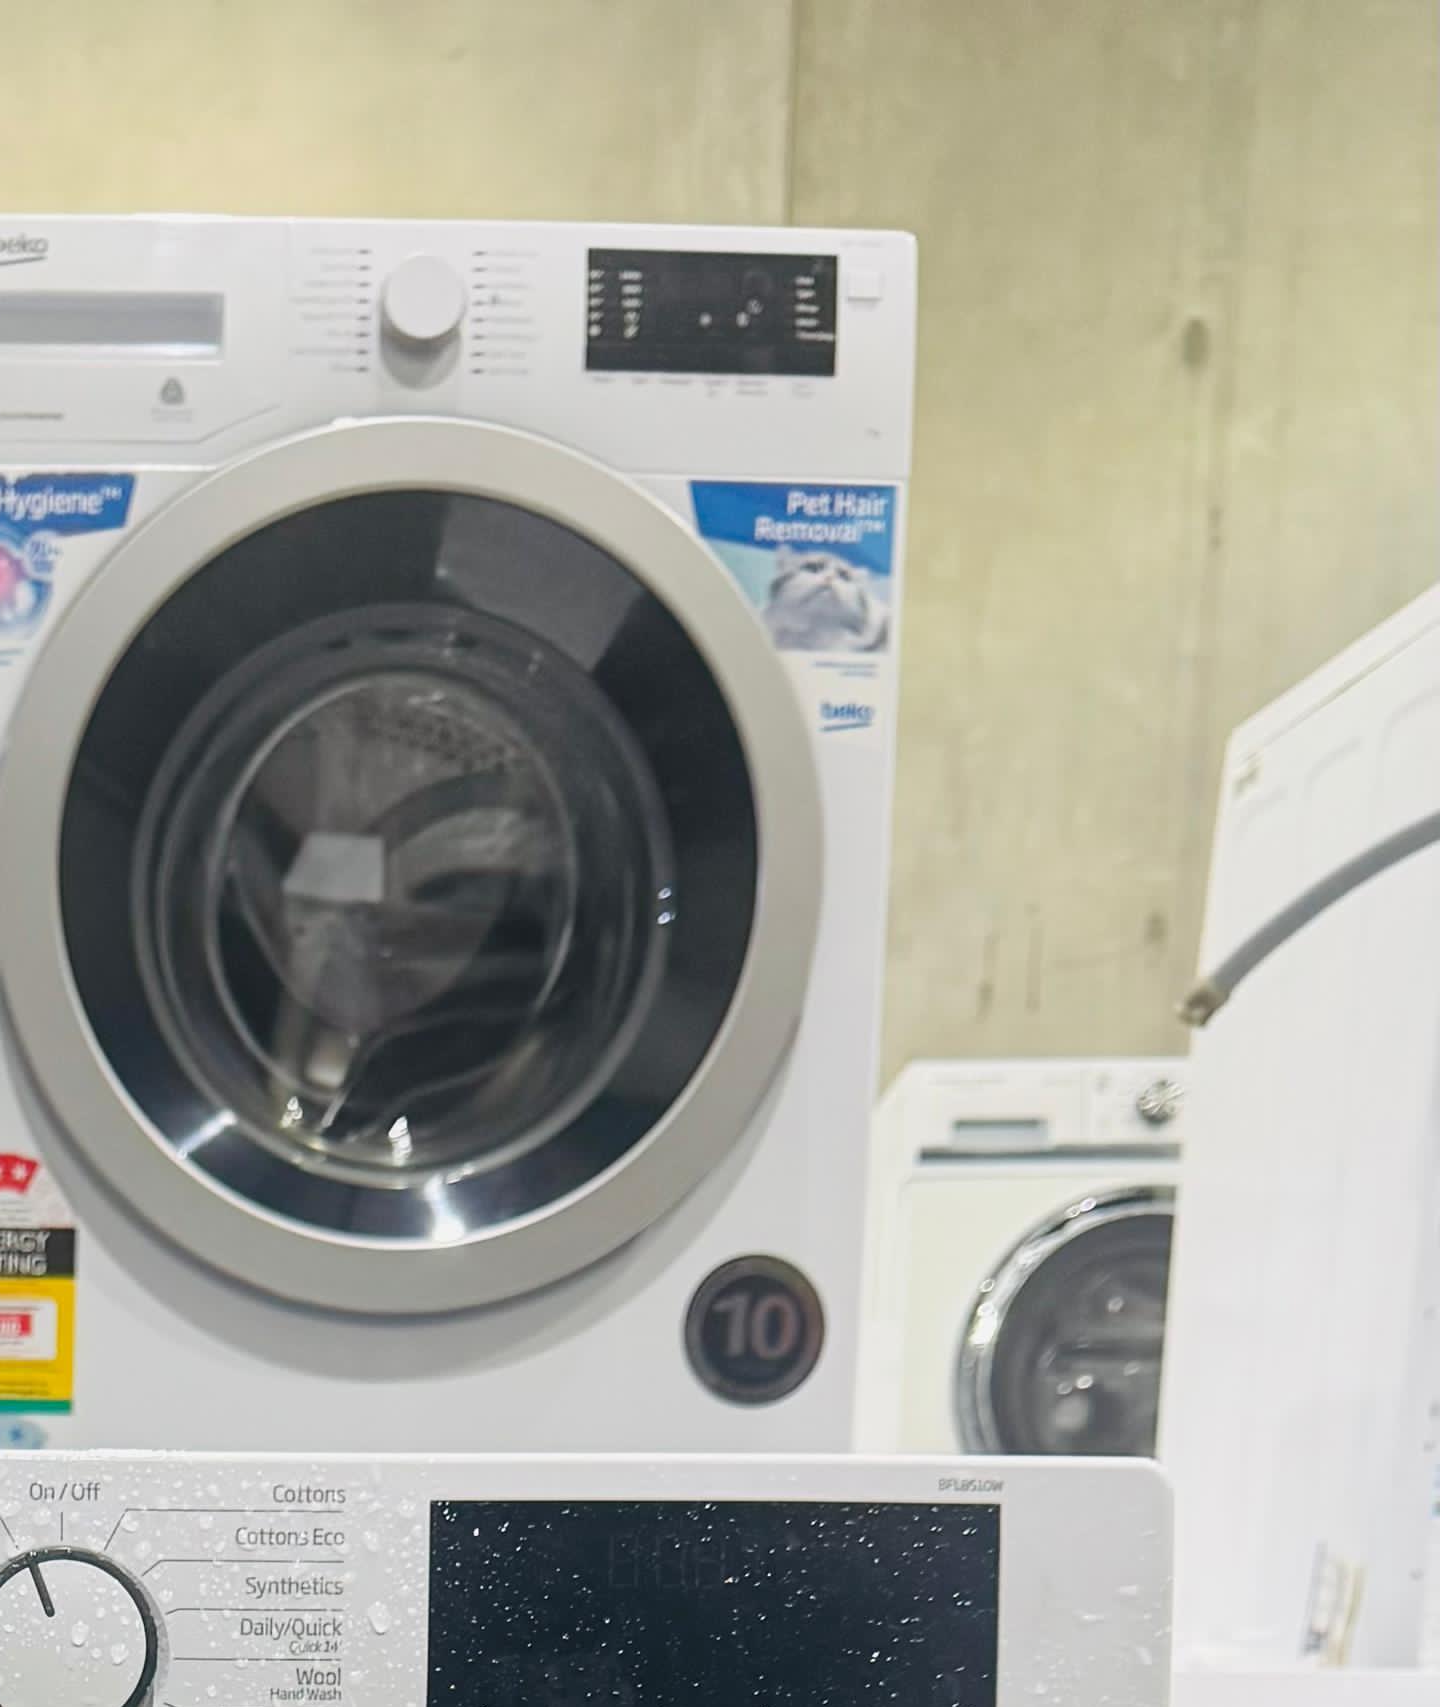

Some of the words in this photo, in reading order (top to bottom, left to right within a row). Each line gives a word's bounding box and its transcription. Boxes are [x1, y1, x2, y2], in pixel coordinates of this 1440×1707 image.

[787, 491, 830, 516] Pet
[834, 493, 888, 516] Hair
[711, 1292, 801, 1360] 10
[273, 1484, 346, 1504] Cottons
[235, 1527, 309, 1546] Cottons
[313, 1528, 345, 1546] Eco
[245, 1576, 344, 1599] Synthetics
[240, 1617, 343, 1641] Daily/Quick
[296, 1667, 341, 1686] Wool
[270, 1688, 304, 1701] Hand
[306, 1688, 342, 1701] Wash
